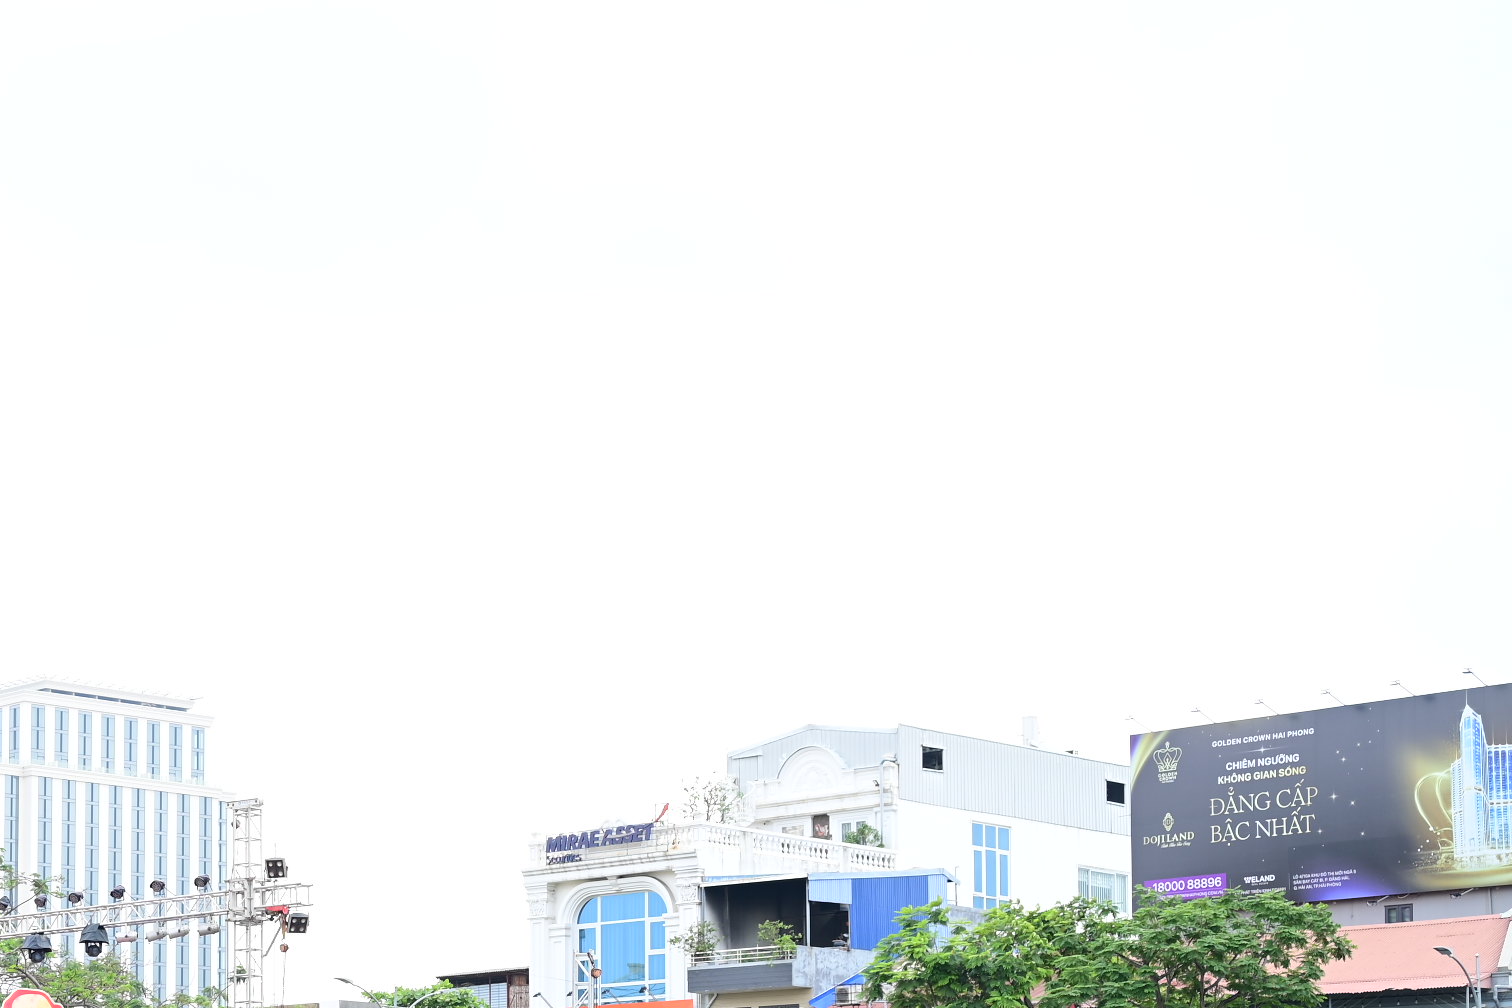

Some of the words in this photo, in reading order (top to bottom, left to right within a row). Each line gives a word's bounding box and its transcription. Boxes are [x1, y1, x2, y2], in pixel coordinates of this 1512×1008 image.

[1211, 737, 1242, 748] GOLDEN
[1243, 733, 1271, 744] CROWN
[1272, 731, 1286, 740] HAI
[1287, 727, 1315, 738] PHONG
[1225, 758, 1256, 771] CHIÊM
[1257, 753, 1300, 767] NGƯỠNG
[1217, 772, 1252, 785] KHÔNG
[1253, 769, 1277, 781] GIAN
[1278, 765, 1307, 777] SỐNG
[1209, 787, 1271, 816] ĐẲNG
[1275, 779, 1318, 809] CẤP
[1210, 818, 1251, 847] BẬC
[1255, 806, 1316, 839] NHẤT
[546, 830, 599, 853] MIRAE
[600, 822, 654, 846] ASSET
[1152, 880, 1185, 893] 18000
[1187, 876, 1222, 890] 88896
